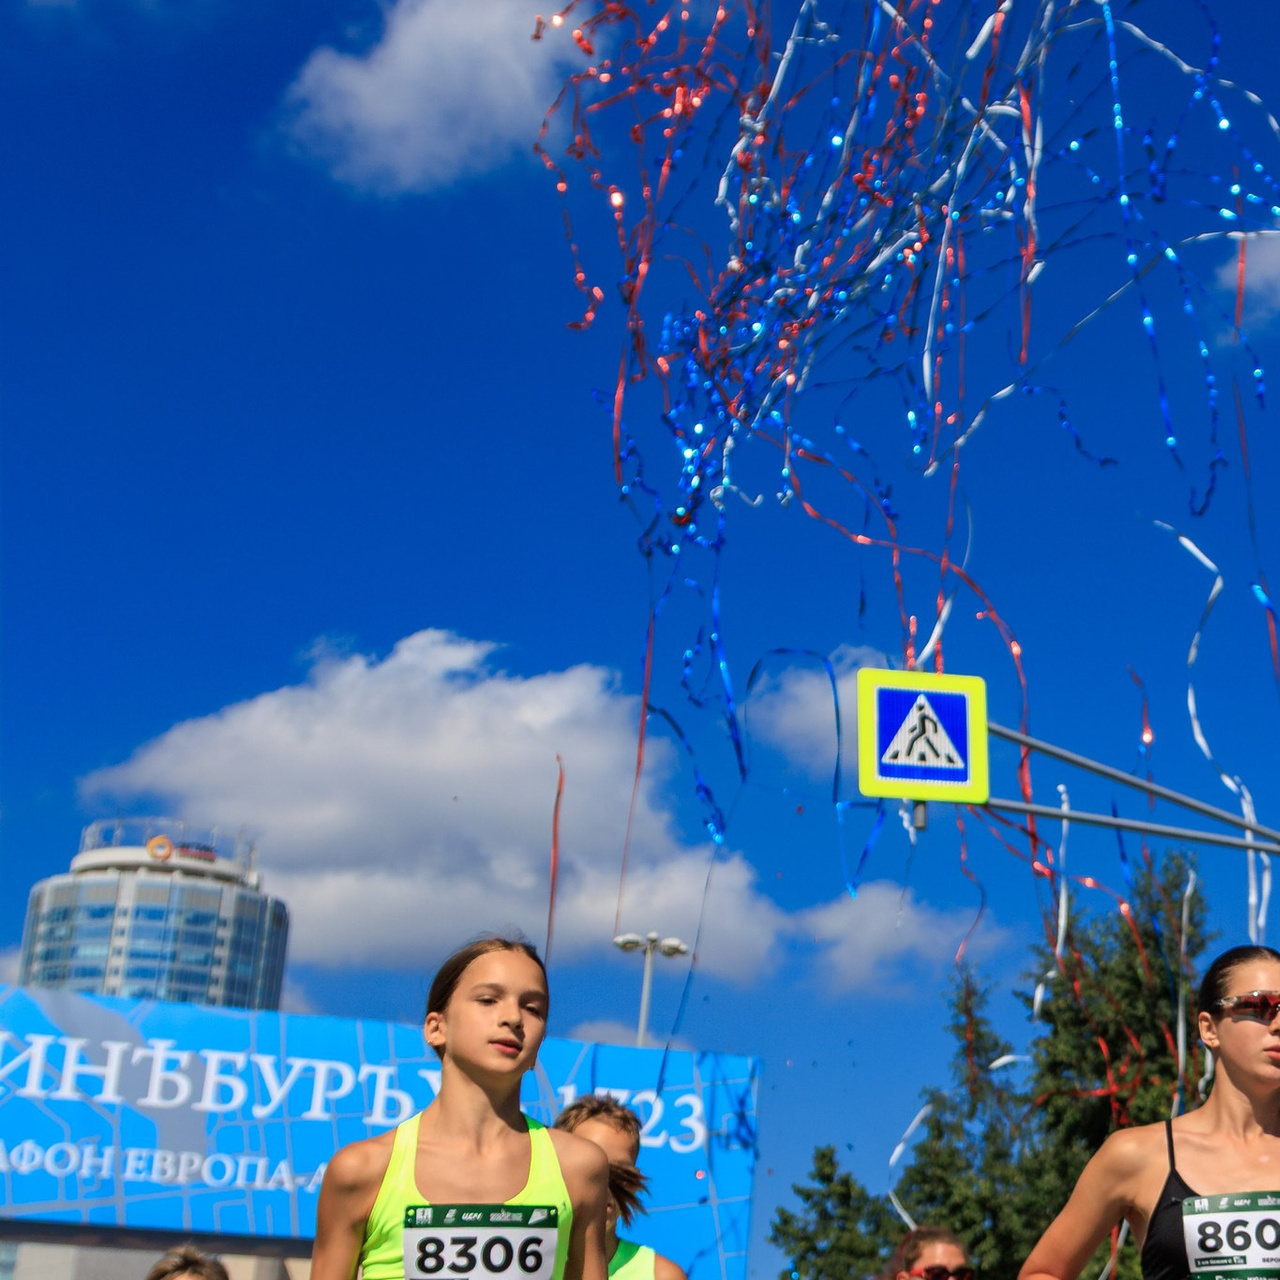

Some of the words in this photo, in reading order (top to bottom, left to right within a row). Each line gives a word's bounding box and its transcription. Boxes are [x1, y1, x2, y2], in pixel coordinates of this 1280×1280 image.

[556, 1084, 706, 1152] 23
[0, 1138, 115, 1181] ФОН
[415, 1235, 543, 1275] 8306
